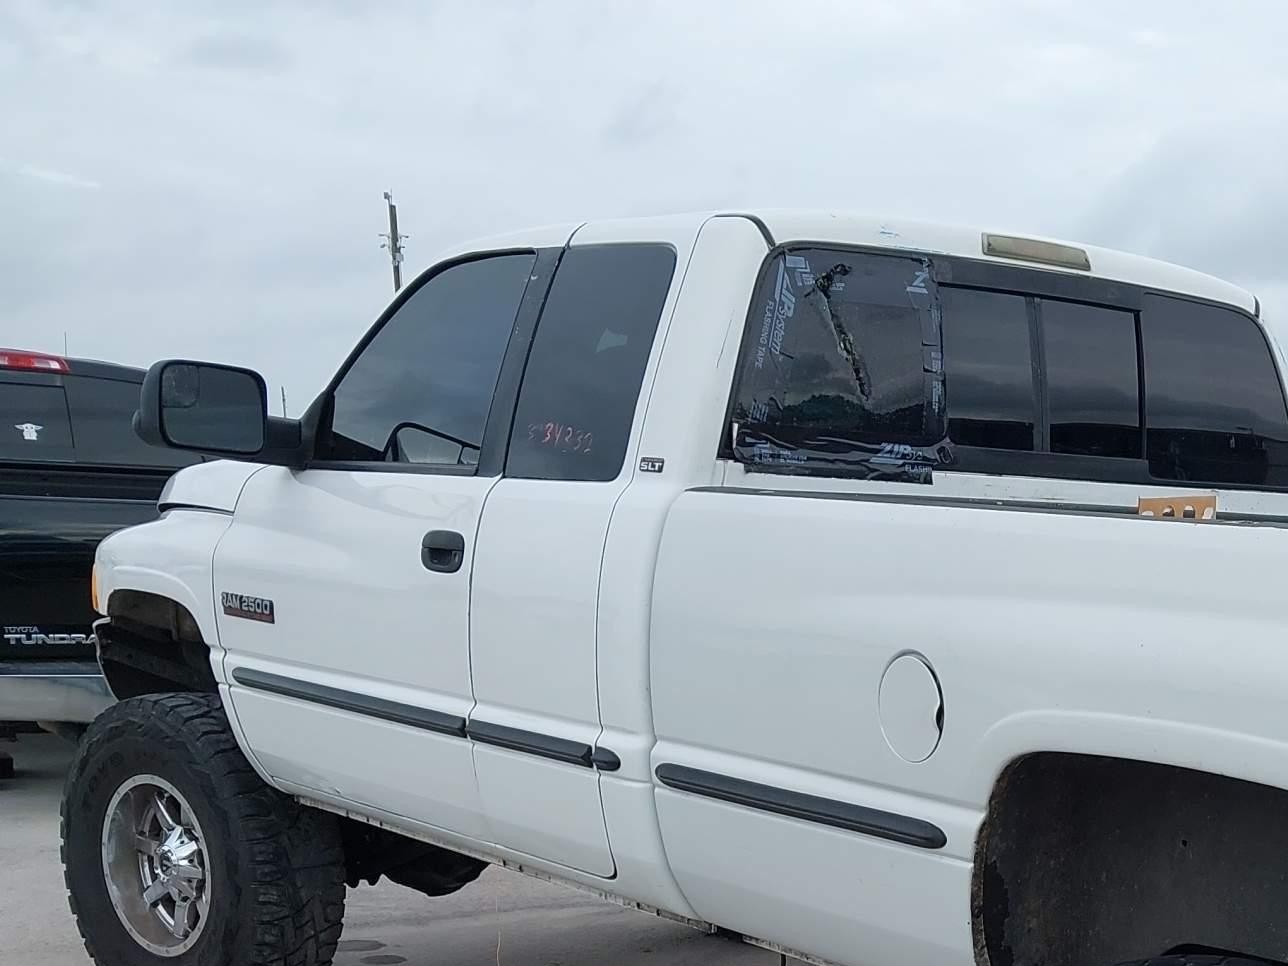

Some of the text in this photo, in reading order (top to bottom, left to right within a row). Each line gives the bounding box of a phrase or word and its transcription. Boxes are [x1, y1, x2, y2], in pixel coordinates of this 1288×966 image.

[759, 300, 775, 344] FLASHING
[640, 461, 662, 471] SLT
[222, 593, 240, 609] RAM
[242, 596, 270, 615] 2500
